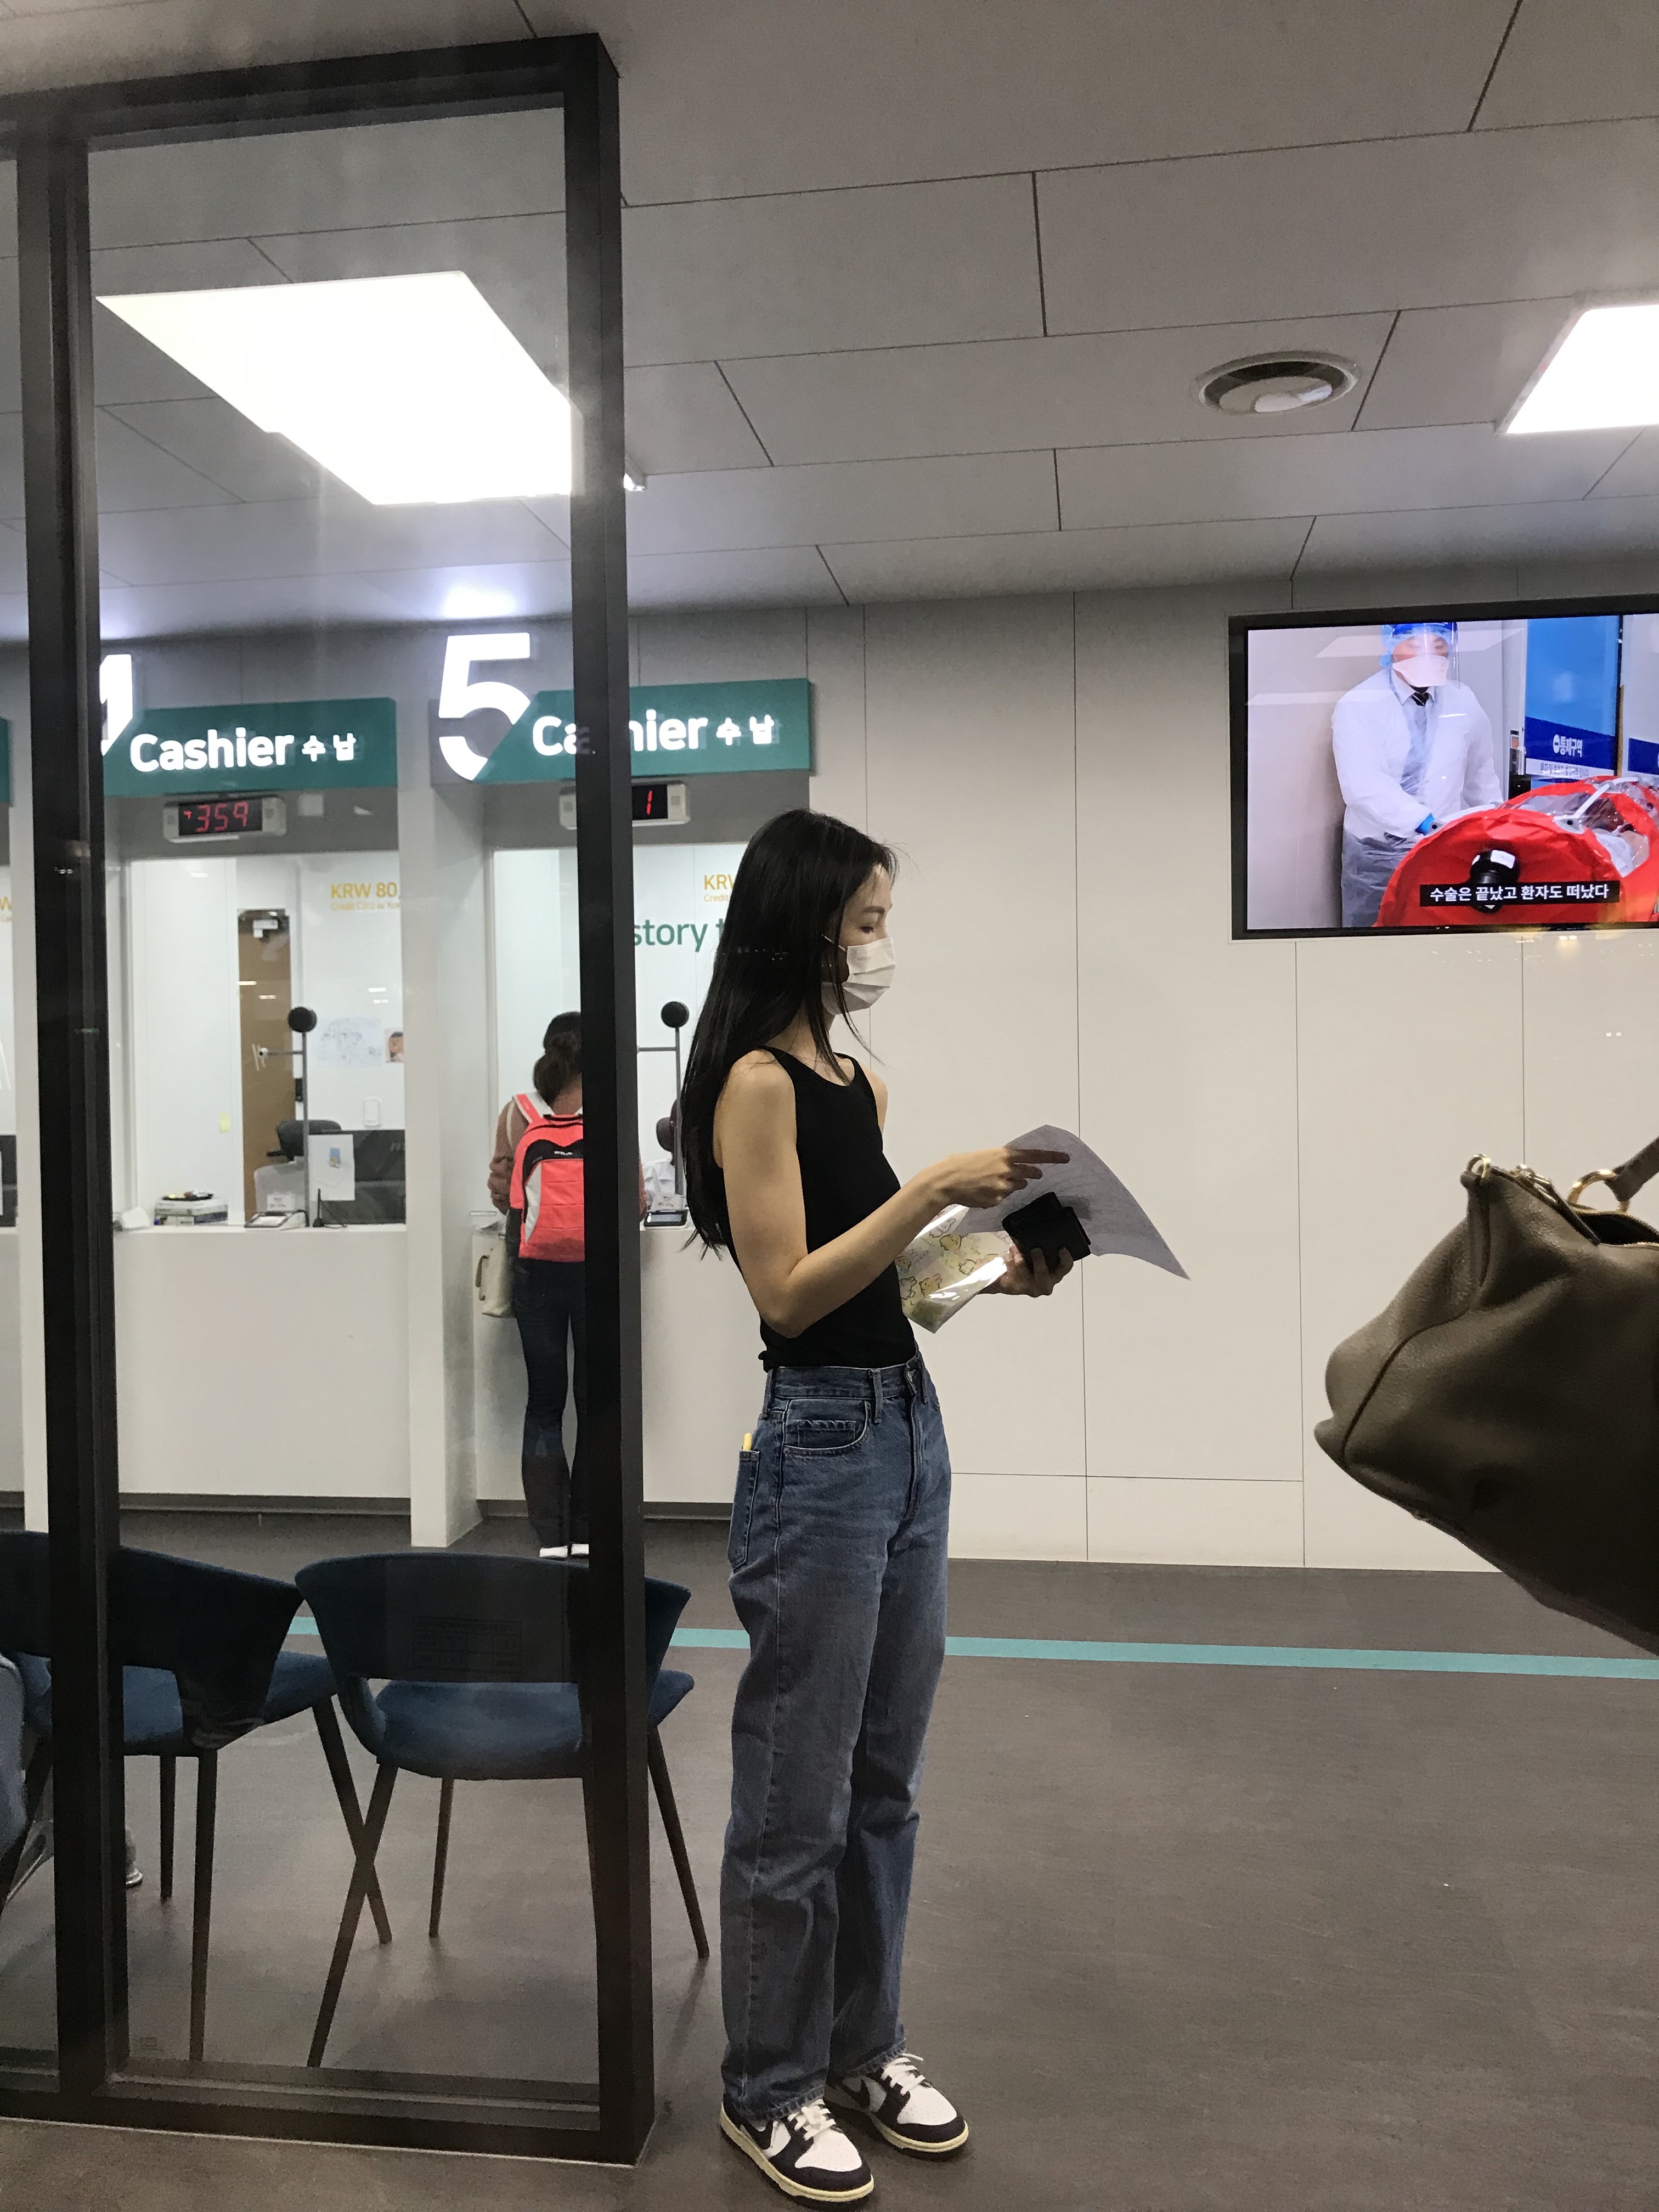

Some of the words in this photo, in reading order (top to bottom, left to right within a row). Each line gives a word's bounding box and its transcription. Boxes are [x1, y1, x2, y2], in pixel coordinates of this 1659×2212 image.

[438, 632, 531, 781] 5
[129, 727, 295, 772] Cashier
[196, 800, 249, 833] 359
[331, 882, 371, 899] KRW
[703, 894, 729, 902] Credit
[1430, 887, 1472, 902] 수술은
[1475, 885, 1517, 901] 끝났고
[1520, 884, 1563, 900] 환자도
[1566, 883, 1610, 899] 떠났다
